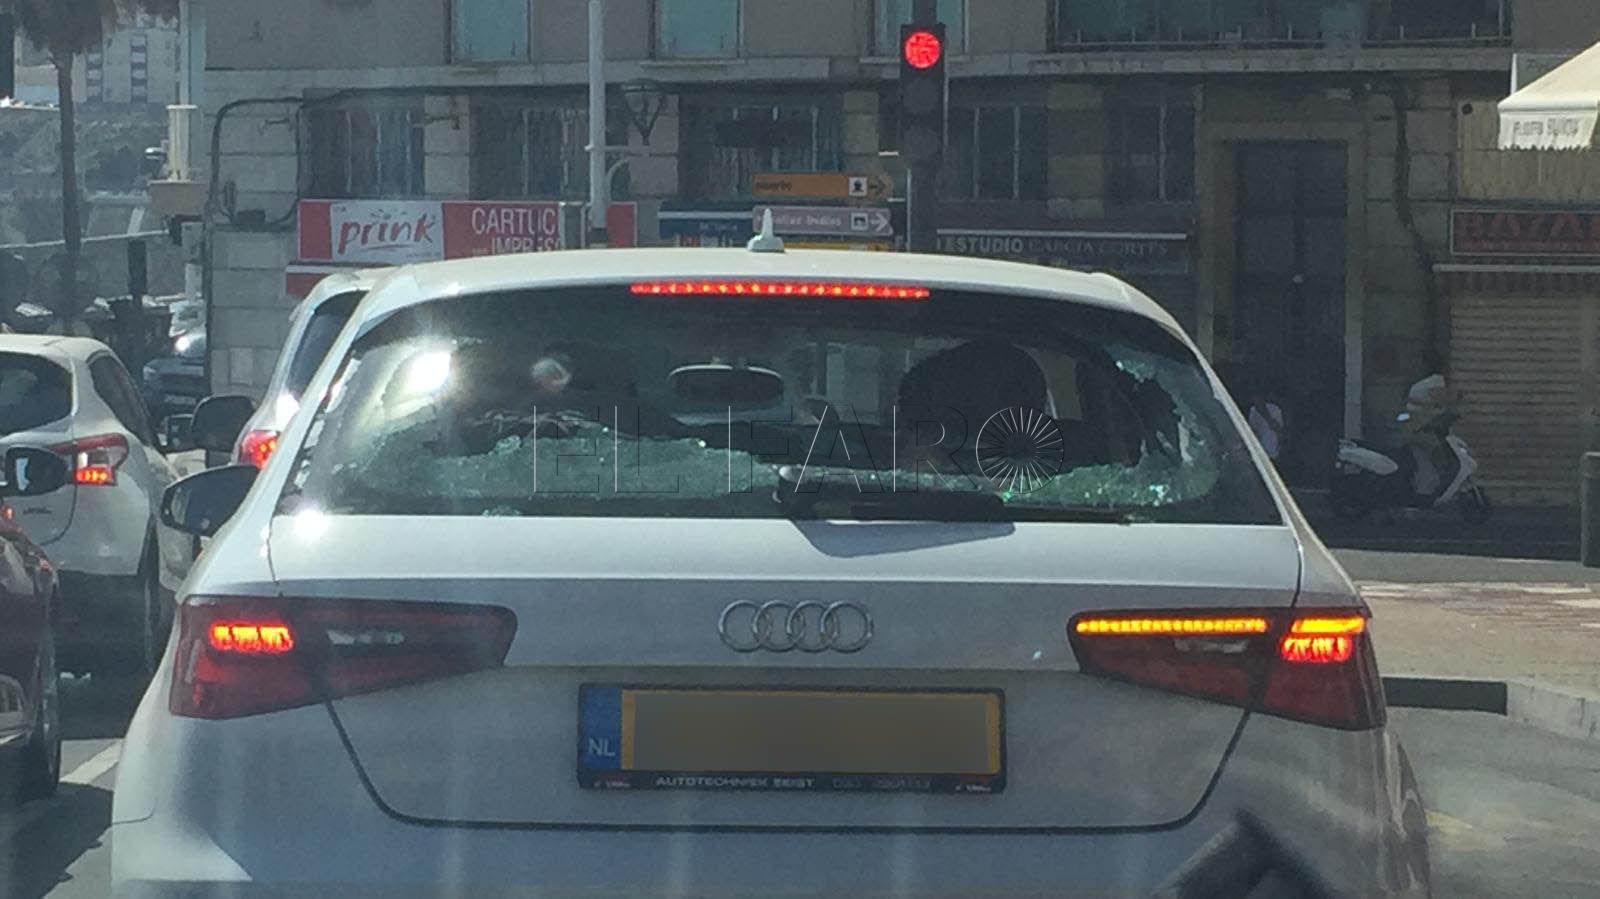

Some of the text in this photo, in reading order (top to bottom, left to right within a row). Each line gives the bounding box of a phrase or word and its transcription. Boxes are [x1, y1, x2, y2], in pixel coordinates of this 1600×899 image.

[471, 207, 560, 235] CARTUC
[337, 213, 435, 255] prink
[944, 237, 1024, 254] ESTUDIO
[588, 737, 616, 757] NL
